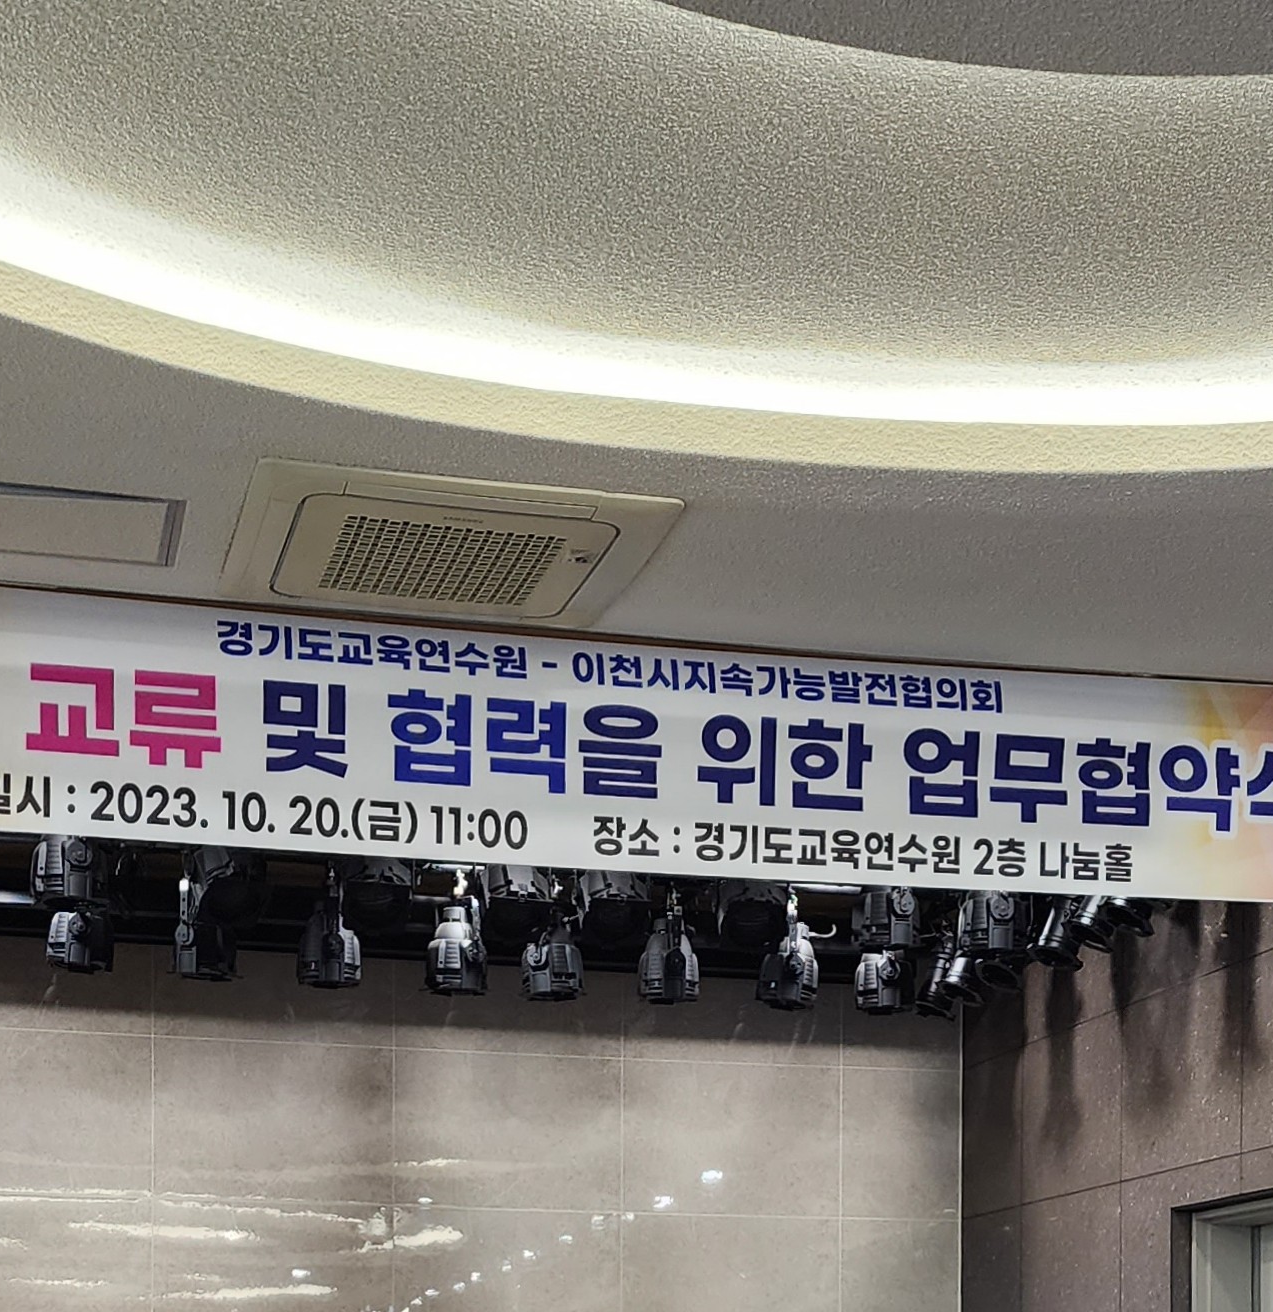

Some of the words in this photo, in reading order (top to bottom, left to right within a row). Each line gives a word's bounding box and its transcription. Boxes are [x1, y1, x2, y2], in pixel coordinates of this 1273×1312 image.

[216, 619, 528, 680] 경기도교육연수원
[571, 651, 1004, 714] 이천시지속가능발전협의회
[25, 662, 222, 770] 교류
[262, 679, 349, 779] 및
[386, 688, 663, 800] 협력을
[696, 713, 874, 813] 위한
[89, 780, 209, 829] 2023.
[221, 790, 276, 834] 10.
[289, 796, 419, 845] 20.(금)
[429, 805, 528, 851] 11:00
[592, 815, 662, 858] 장소
[693, 822, 961, 876] 경기도교육연수원
[972, 837, 1028, 878] 2층
[1039, 840, 1134, 884] 나눔홀
